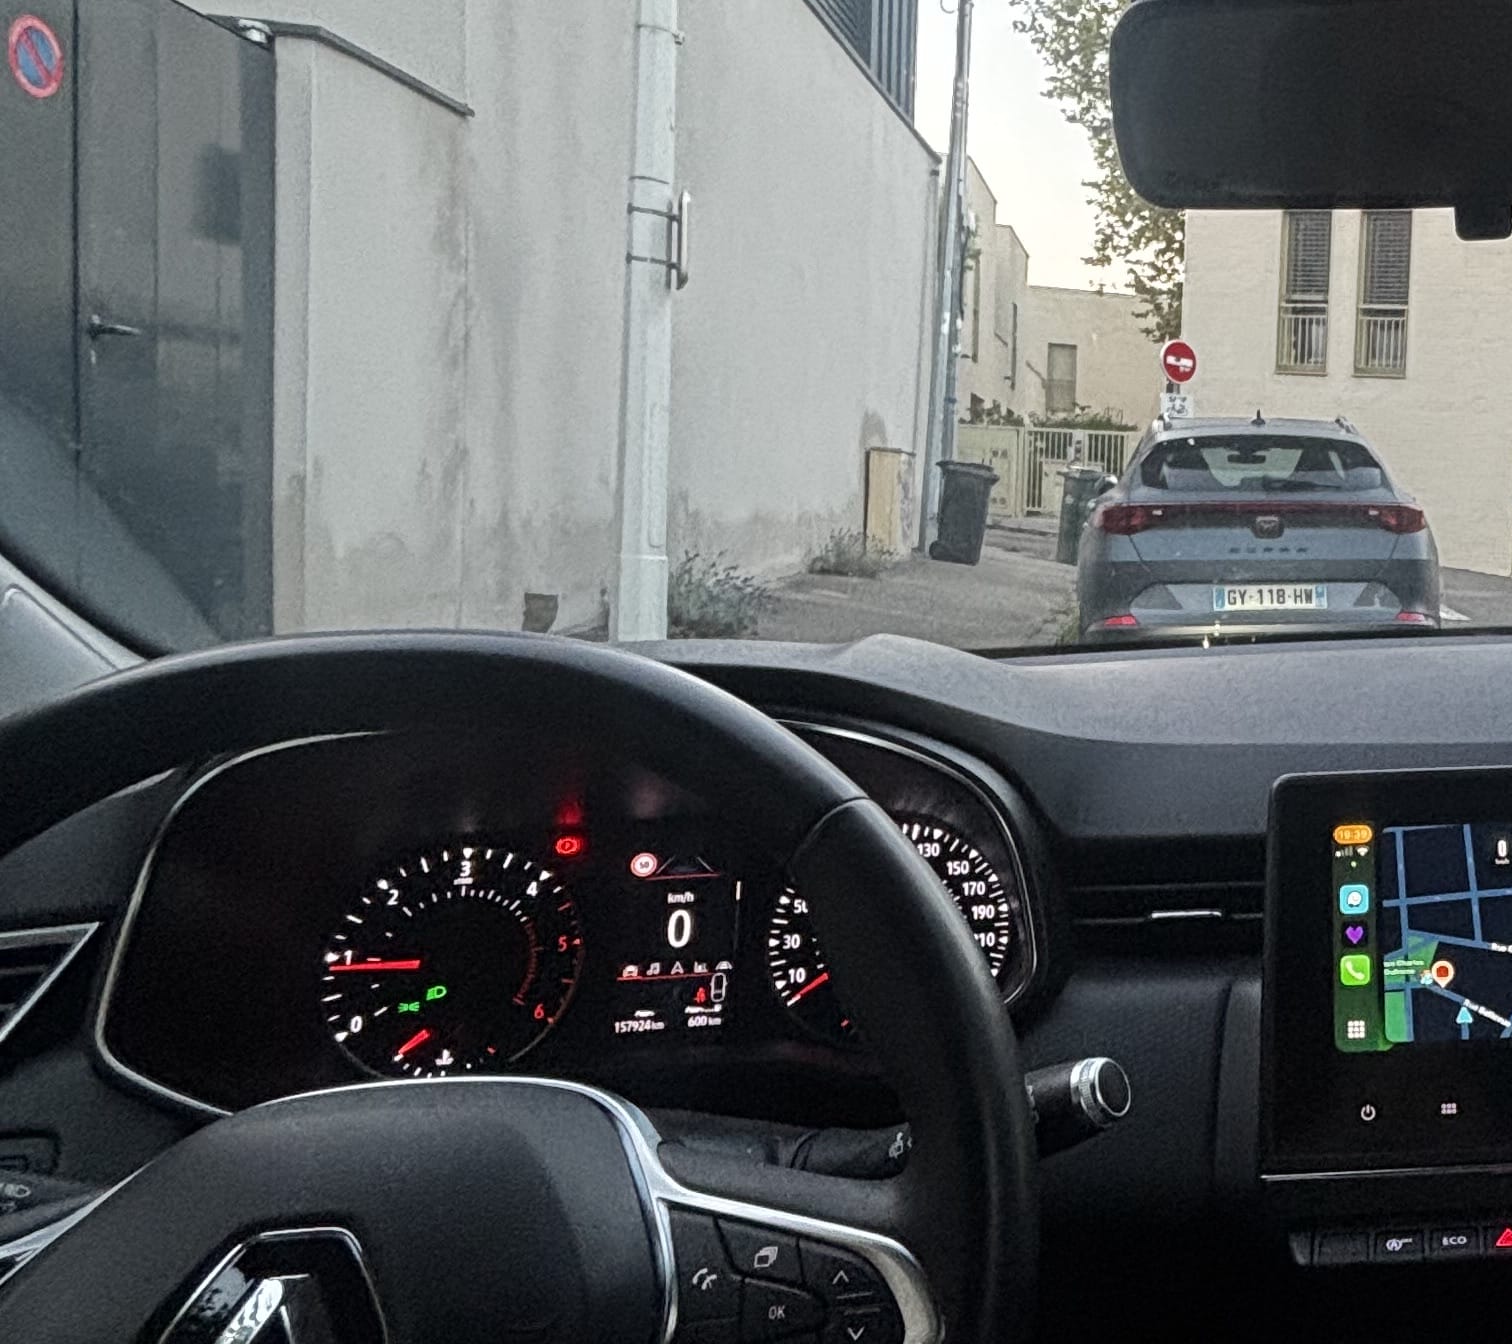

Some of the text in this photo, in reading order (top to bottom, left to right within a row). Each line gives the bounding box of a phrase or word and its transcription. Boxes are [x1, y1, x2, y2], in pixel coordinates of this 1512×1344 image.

[1227, 587, 1313, 606] GY-118-HW
[917, 842, 941, 857] 130
[1496, 839, 1507, 857] 0
[461, 860, 472, 877] 3
[946, 860, 970, 875] 150
[526, 881, 538, 897] 4
[962, 881, 986, 896] 170
[387, 889, 399, 905] 2
[667, 891, 695, 904] km/h
[971, 904, 995, 920] 190
[667, 909, 691, 948] 0
[557, 936, 567, 952] 5
[782, 934, 801, 949] 30
[974, 932, 996, 947] 10
[344, 950, 353, 966] 1
[788, 967, 806, 983] 10
[533, 1003, 545, 1019] 6
[350, 1015, 363, 1033] 0
[688, 1016, 721, 1027] 600 km
[1442, 1235, 1467, 1246] ECO
[768, 1305, 787, 1320] OK
